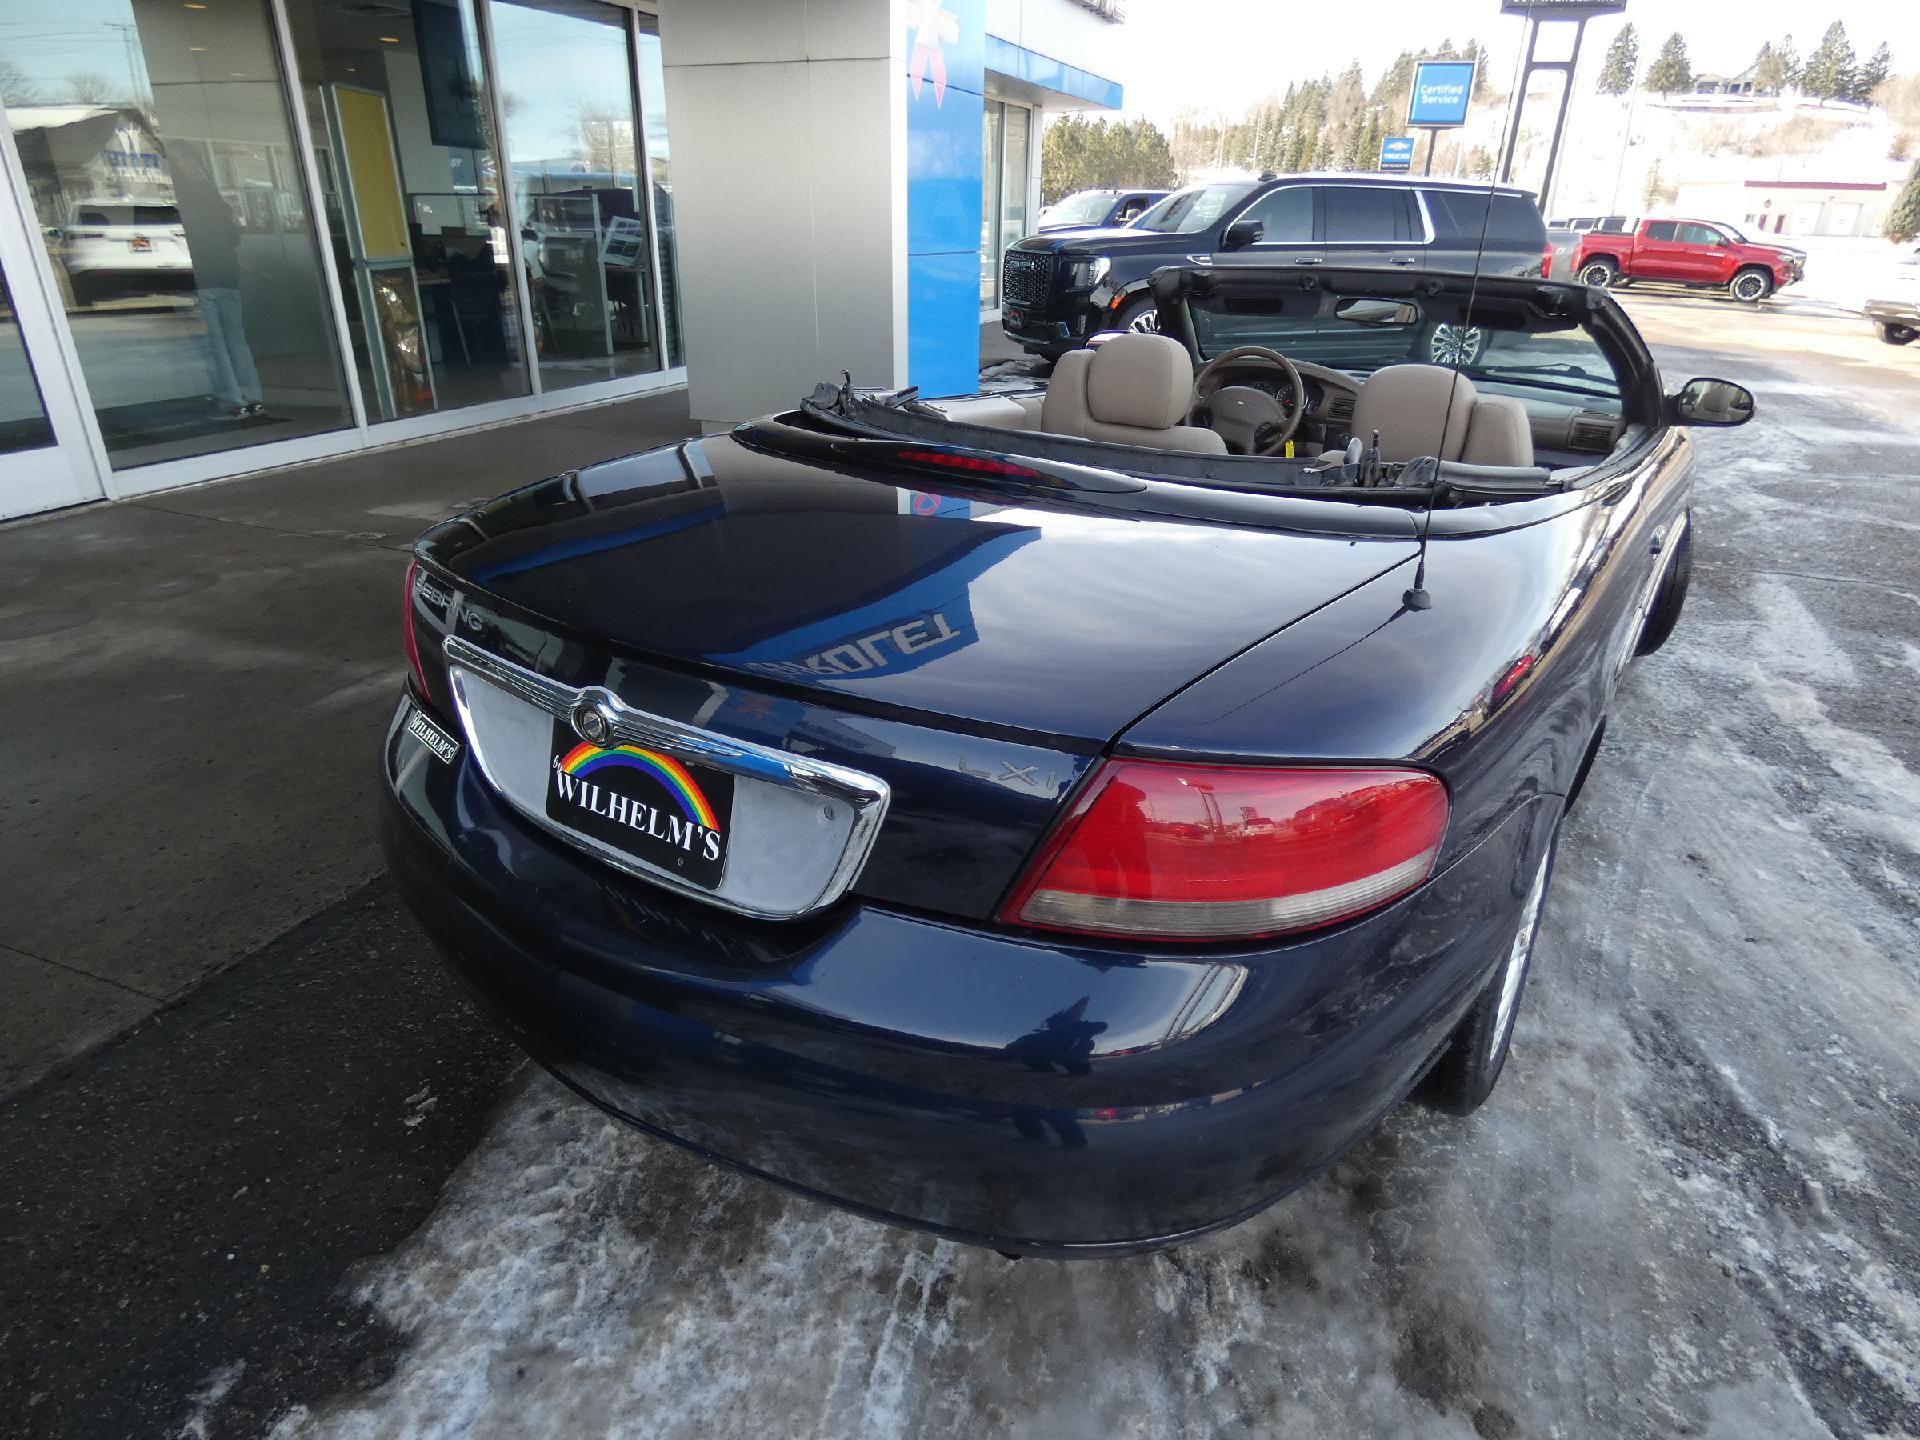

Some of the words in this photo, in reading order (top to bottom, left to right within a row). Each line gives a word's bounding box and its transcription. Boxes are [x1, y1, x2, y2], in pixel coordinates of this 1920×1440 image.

[1421, 84, 1463, 95] Certified
[1421, 95, 1459, 104] Service
[410, 716, 455, 759] WILHELM'S
[556, 772, 721, 862] WILHELM'S
